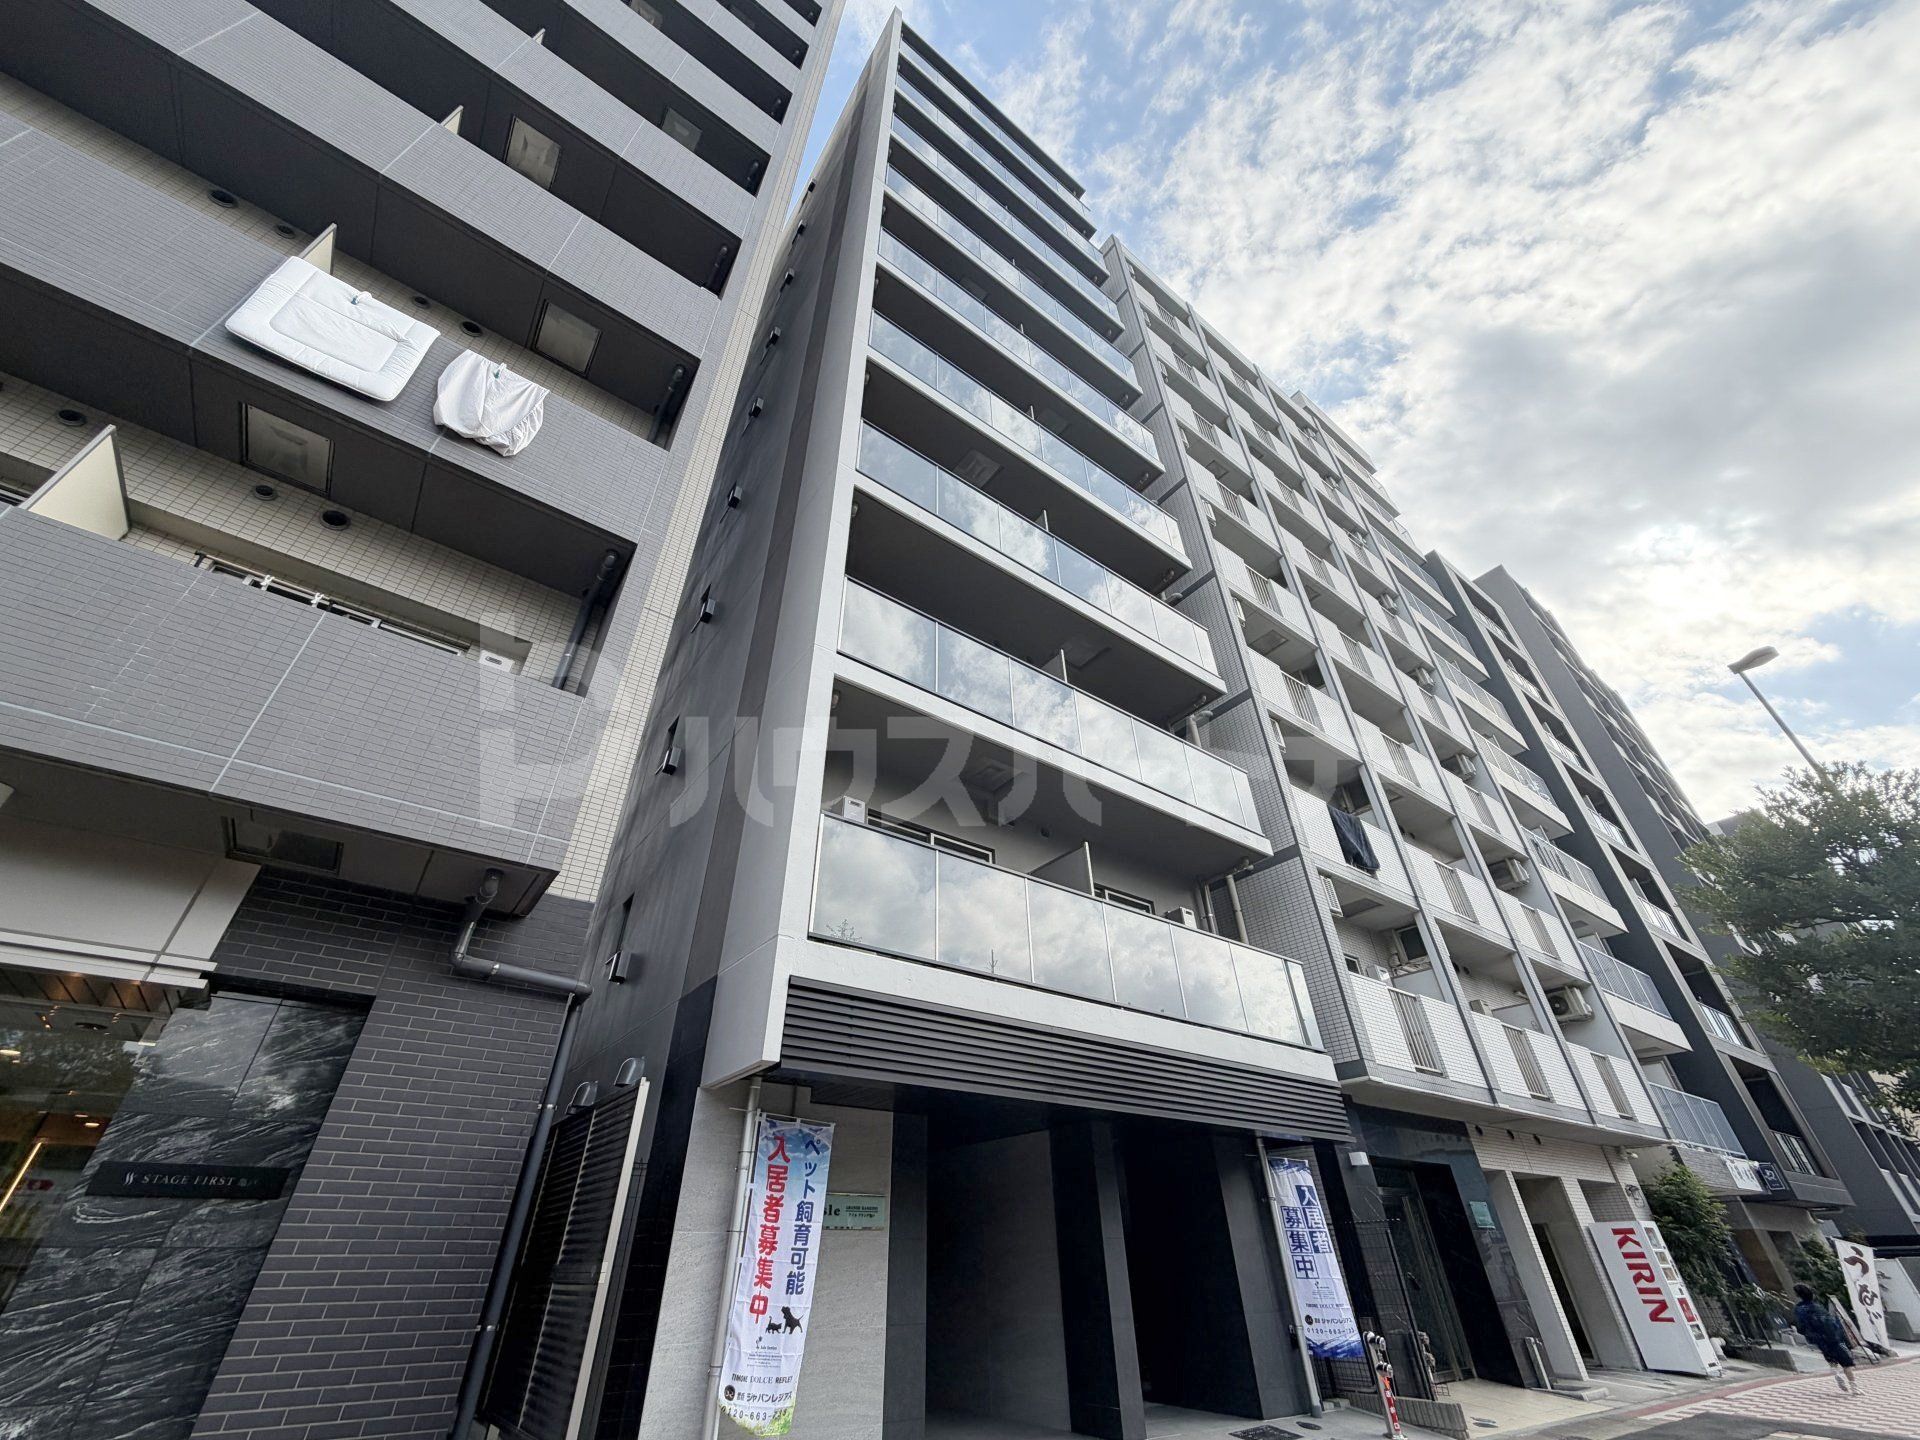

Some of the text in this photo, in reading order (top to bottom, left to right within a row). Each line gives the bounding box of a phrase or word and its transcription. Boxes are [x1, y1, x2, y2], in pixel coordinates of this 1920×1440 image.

[141, 1173, 192, 1186] STAGE
[193, 1175, 236, 1188] FIRST
[749, 1135, 792, 1325] 入居者募集中
[785, 1138, 822, 1296] ペット飼育可能
[1282, 1206, 1319, 1278] 募集中
[1296, 1185, 1332, 1254] 入居者
[1611, 1227, 1676, 1324] KIRIN
[749, 1374, 774, 1384] DOLCE
